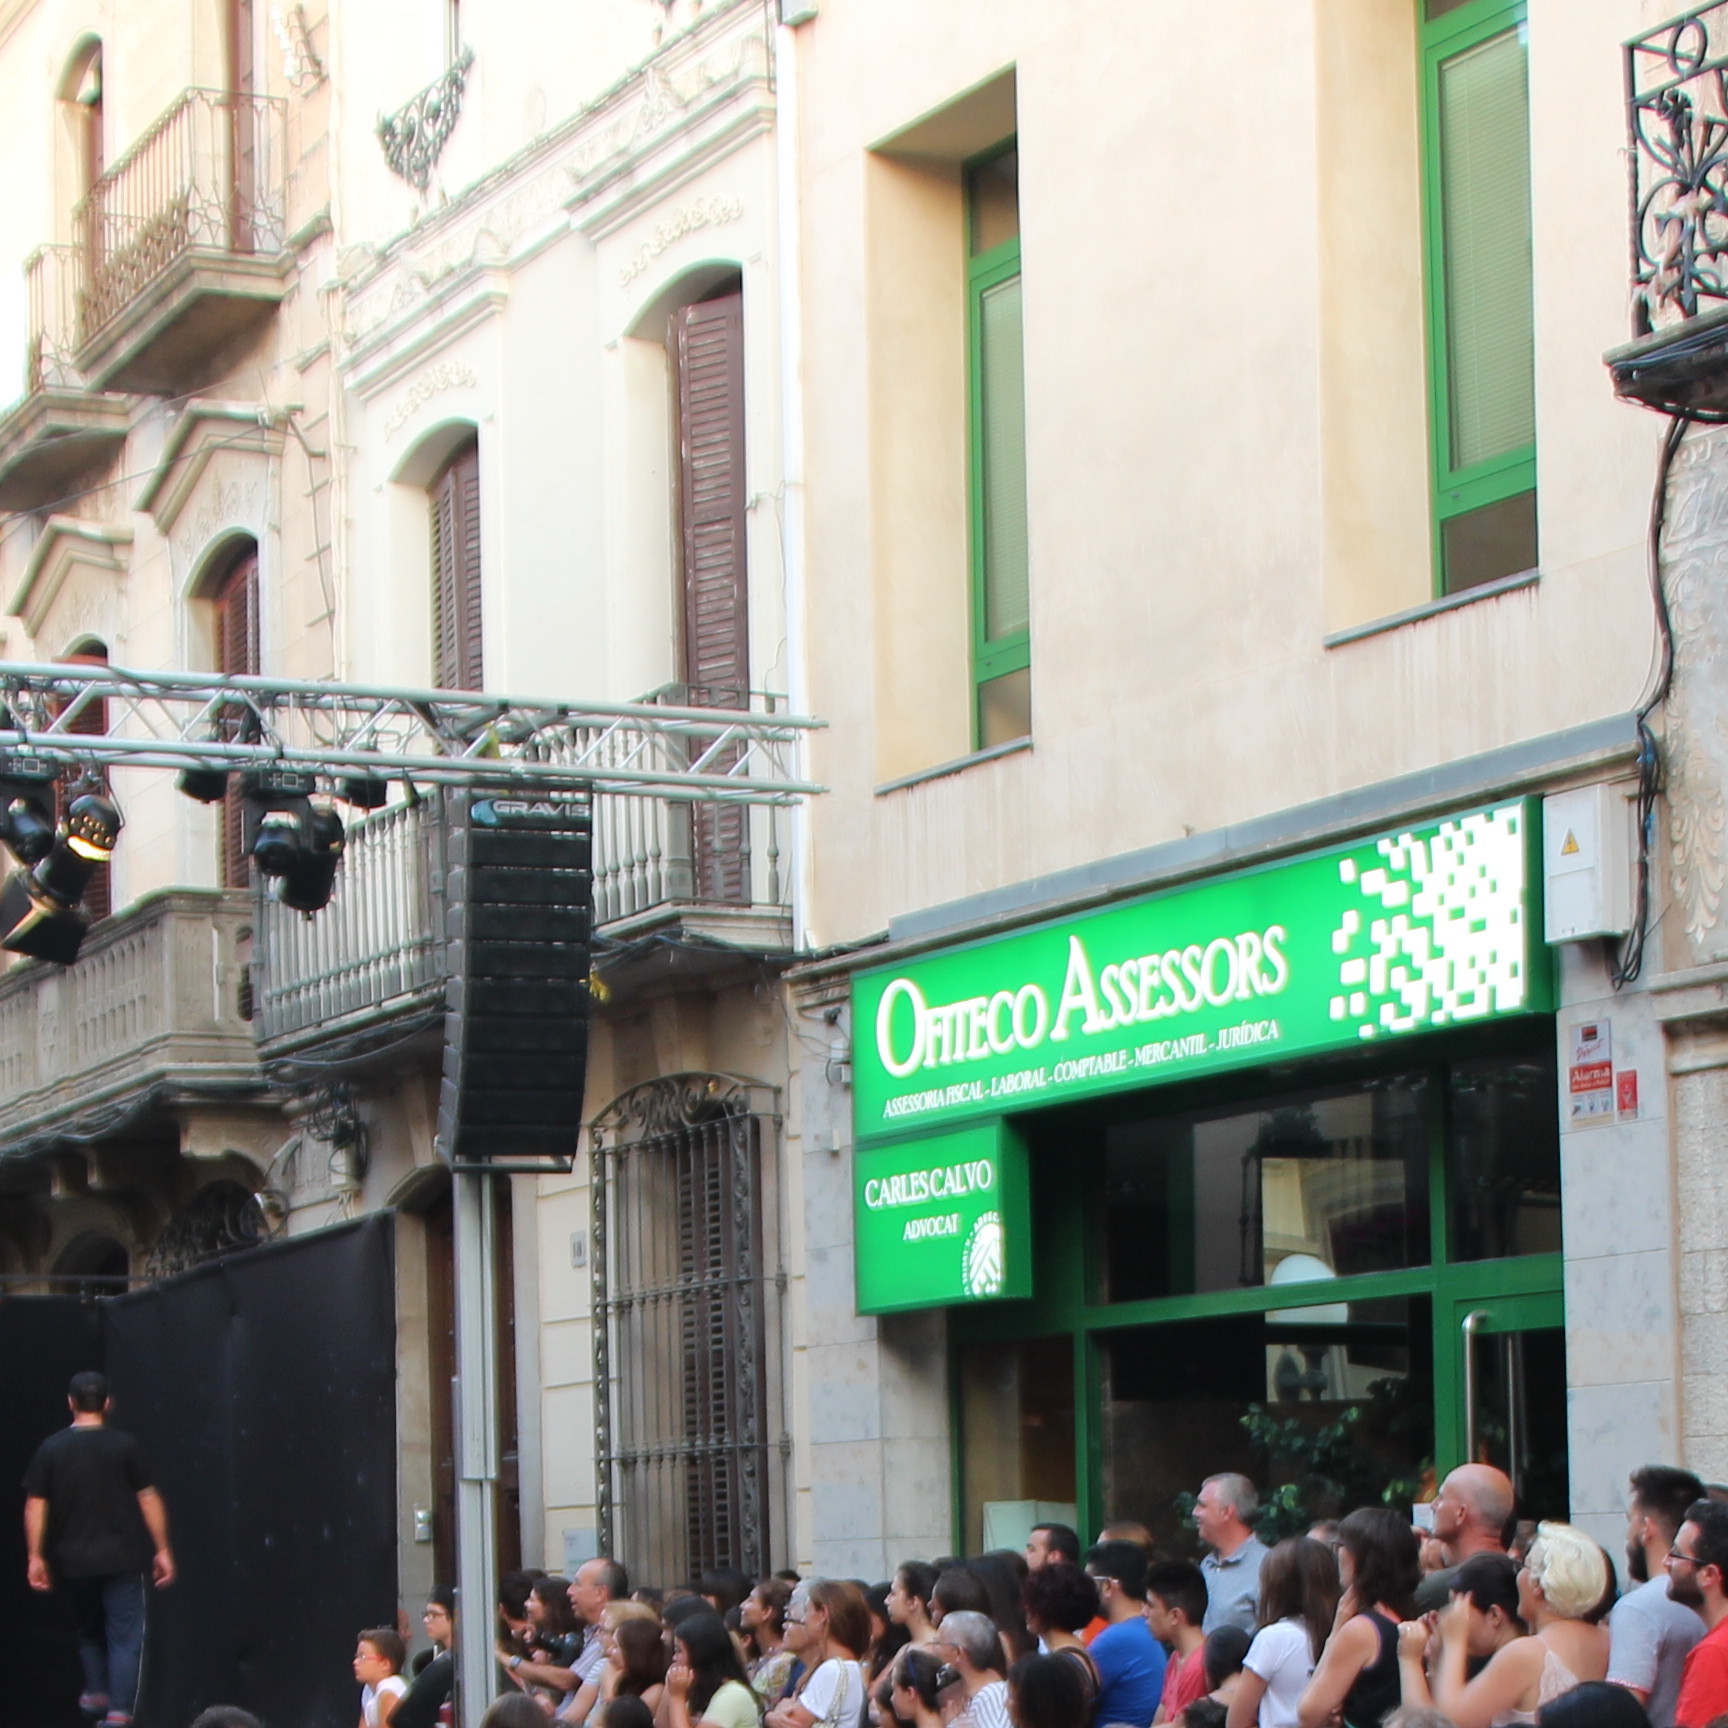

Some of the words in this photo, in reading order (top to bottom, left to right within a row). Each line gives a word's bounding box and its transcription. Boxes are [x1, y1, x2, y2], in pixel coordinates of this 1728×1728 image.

[492, 800, 591, 818] GRAVIS
[876, 977, 1048, 1078] OFITECO
[1050, 925, 1287, 1042] ASSESSORS
[883, 1091, 944, 1118] ASSESSORIA
[945, 1084, 983, 1107] FISCAL
[991, 1067, 1047, 1098] LABORAL
[1054, 1052, 1127, 1084] COMPTABLE
[1135, 1033, 1207, 1066] MERCANTIL
[1216, 1019, 1280, 1051] JURÍDICA
[865, 1171, 929, 1207] CARLES
[930, 1159, 992, 1196] CALVO
[903, 1213, 960, 1240] ADVOCAT
